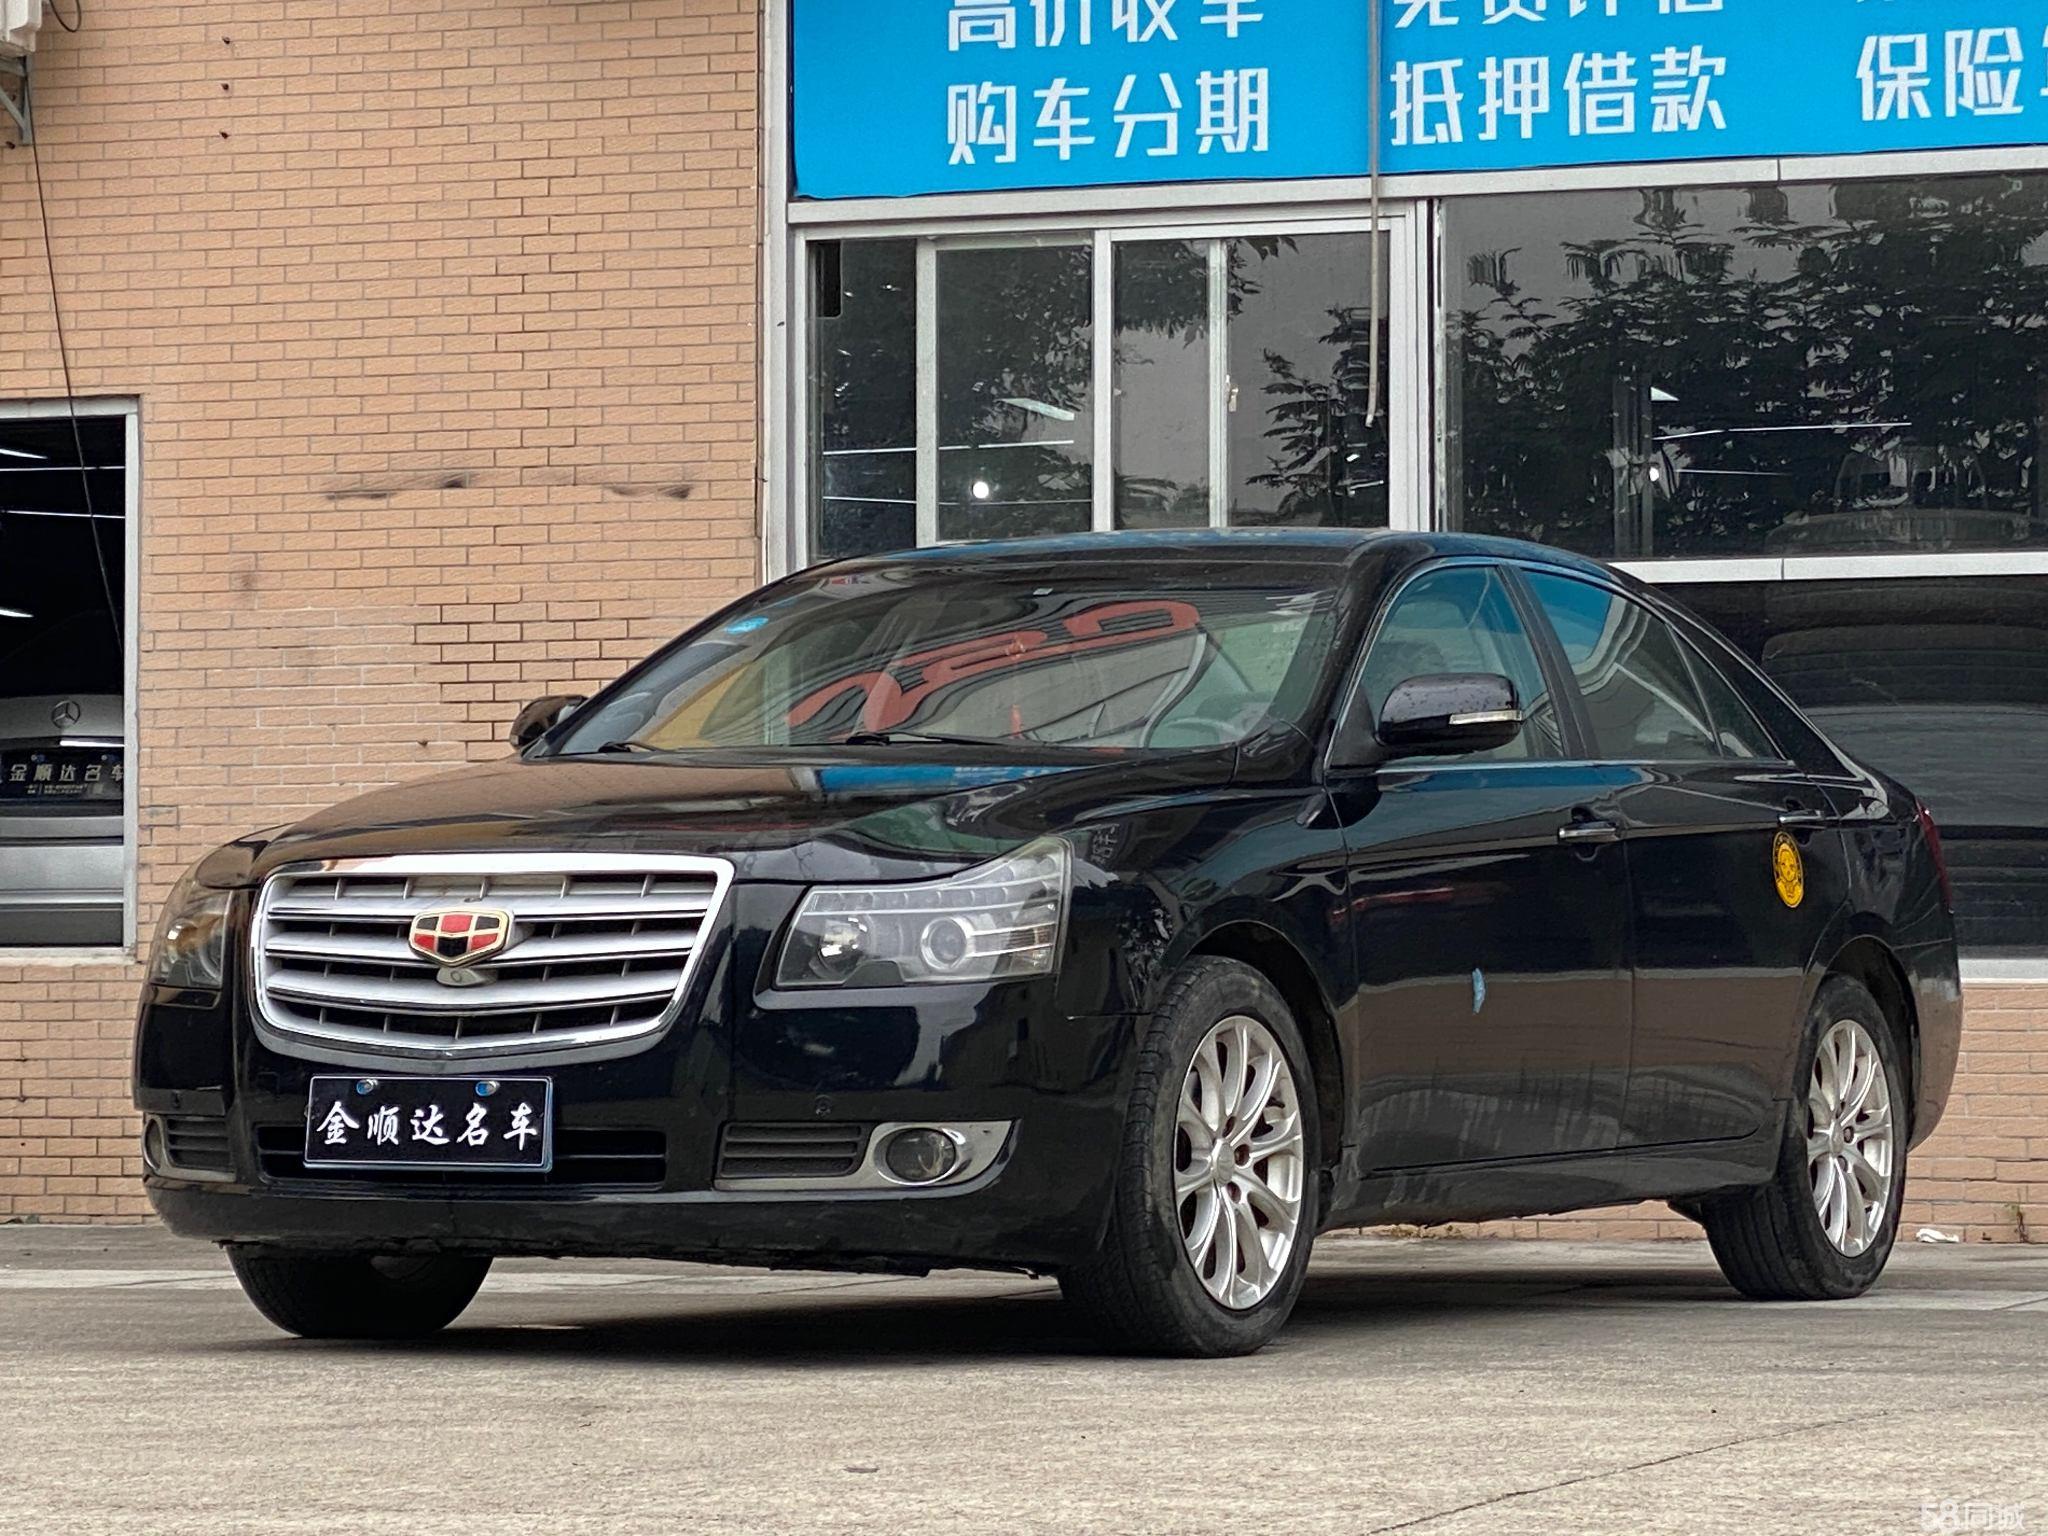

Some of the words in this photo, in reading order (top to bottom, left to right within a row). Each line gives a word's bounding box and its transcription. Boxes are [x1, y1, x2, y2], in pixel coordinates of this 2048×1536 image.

[947, 68, 1268, 165] 购车分期
[1390, 45, 1728, 146] 抵押借款
[1855, 25, 2048, 122] 保险
[316, 1101, 538, 1151] 金顺达名车
